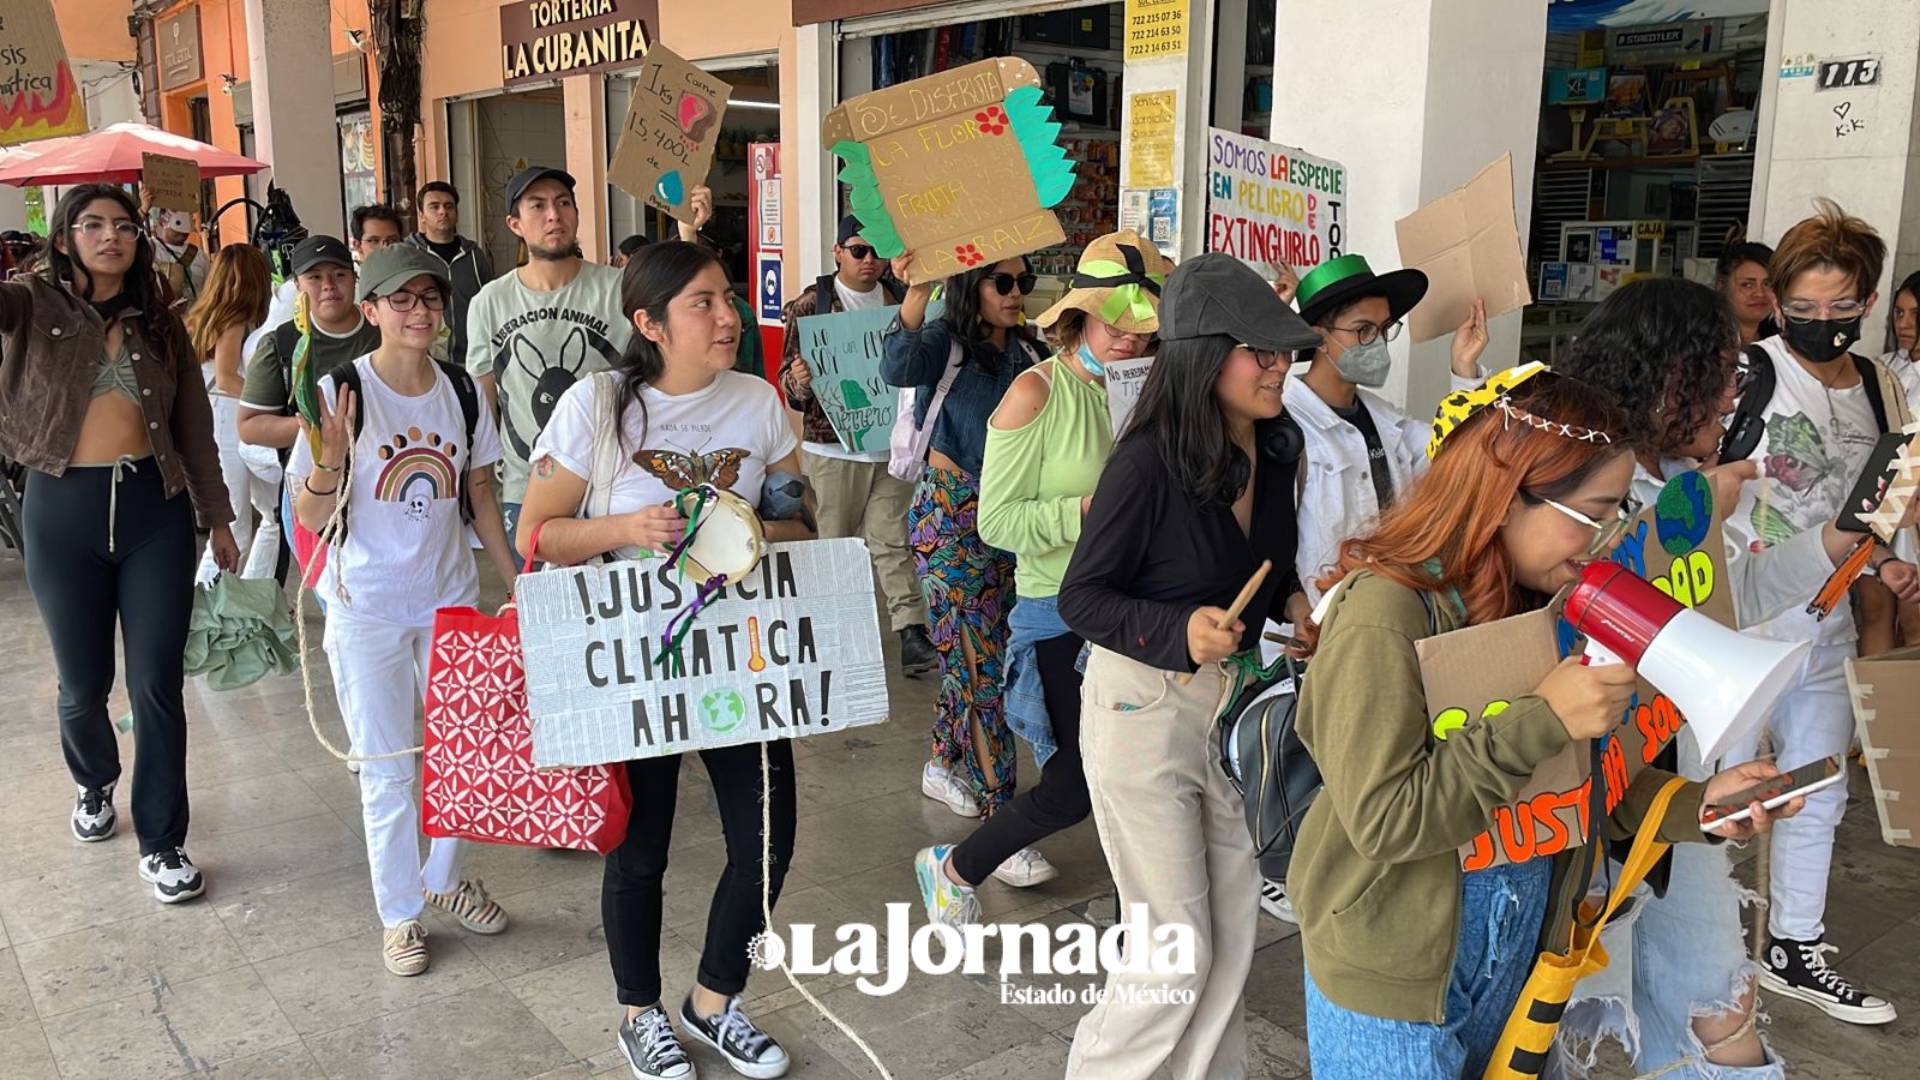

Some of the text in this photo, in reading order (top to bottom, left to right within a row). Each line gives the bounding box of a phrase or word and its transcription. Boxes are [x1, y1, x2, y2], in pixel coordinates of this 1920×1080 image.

[1132, 10, 1181, 25] 722 215 07 36
[1132, 25, 1181, 40] 722 214 63 50
[503, 19, 648, 79] LA CUBANITA
[1130, 45, 1144, 55] 722
[1161, 41, 1170, 51] 63
[1172, 40, 1181, 50] 51
[1626, 30, 1681, 44] STAEDTLER
[0, 44, 26, 66] sis
[685, 72, 717, 97] Carne
[1825, 59, 1878, 87] 113
[910, 72, 1001, 121] DISFRUTA
[870, 118, 984, 167] LA FLOR
[646, 156, 661, 169] de
[1214, 134, 1342, 194] SOMOS LA ESPECIE
[897, 180, 967, 220] FRUTA
[1213, 171, 1316, 229] EN PELIGRO DE
[918, 248, 956, 276] LA
[972, 214, 1054, 253] RAIZ
[1212, 213, 1320, 266] EXTINGUIRLO
[1328, 201, 1341, 260] TOD
[1637, 222, 1663, 236] CAJA
[491, 307, 610, 348] LIBERACION ANIMAL
[1122, 381, 1142, 397] TIE
